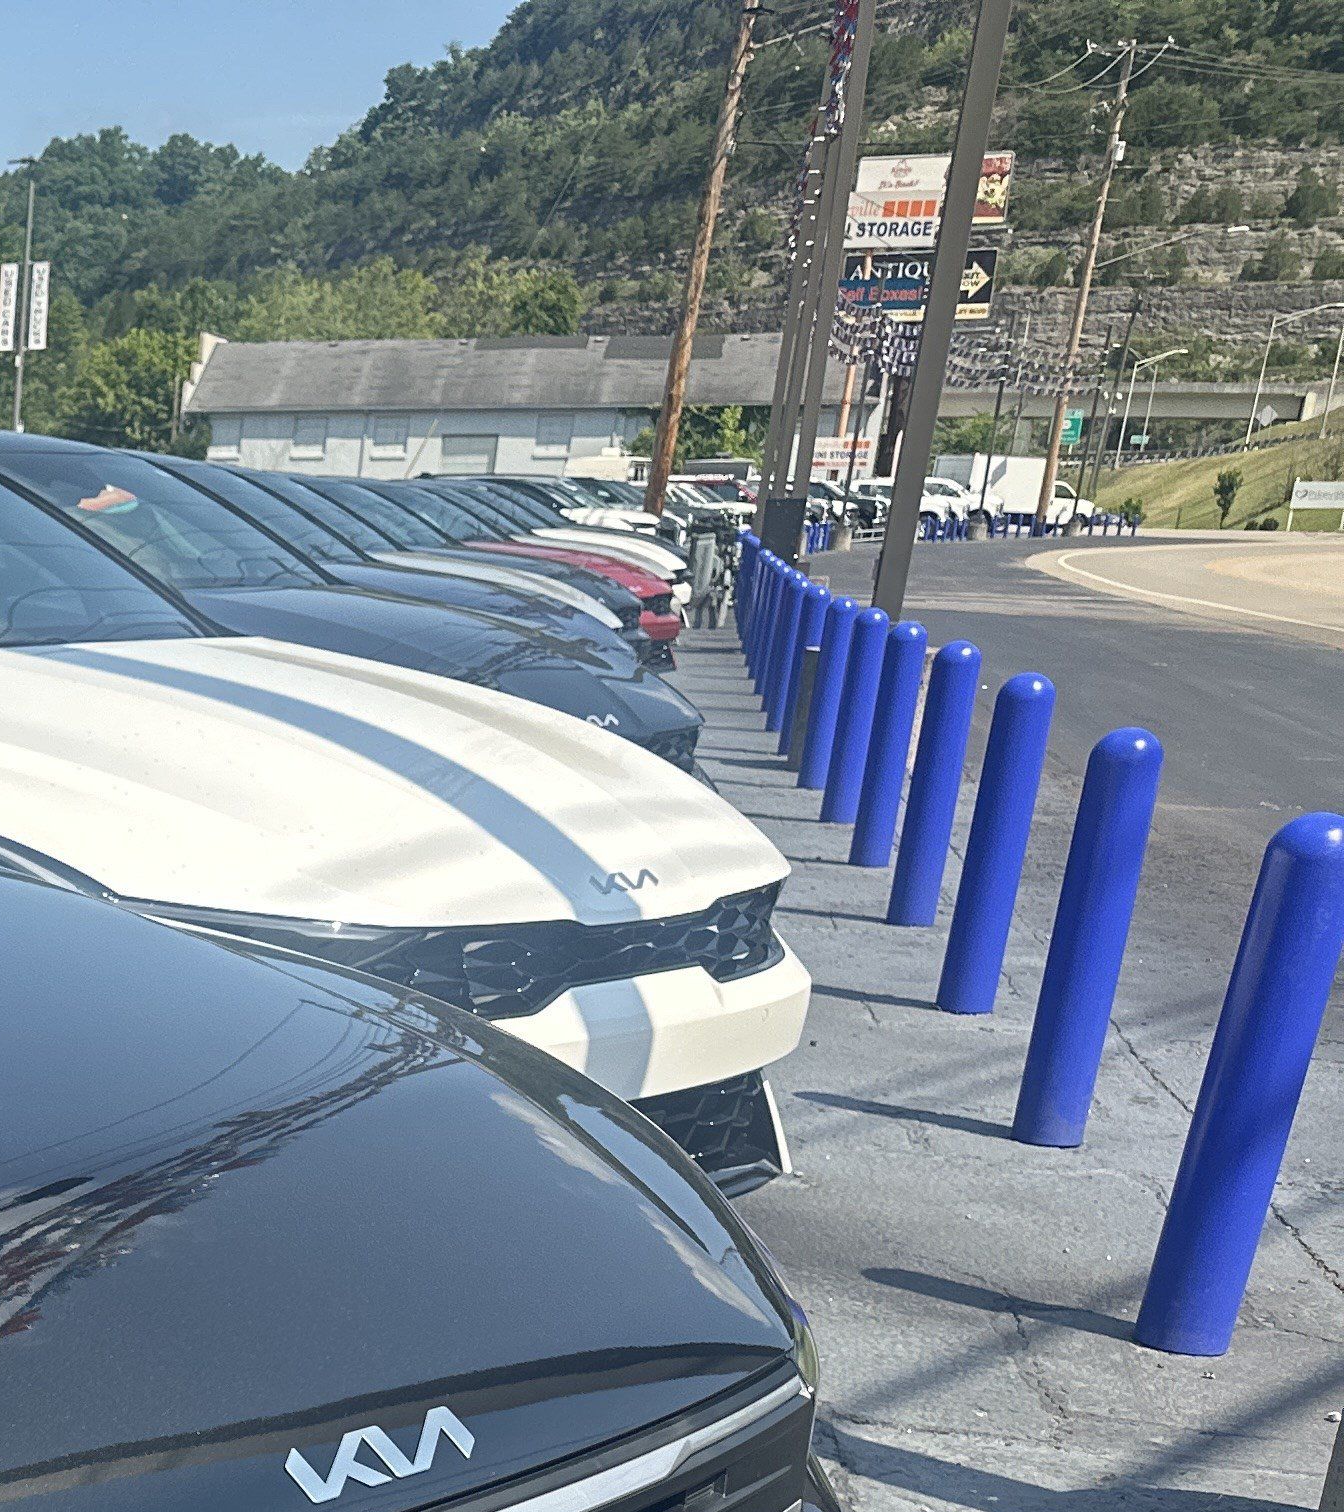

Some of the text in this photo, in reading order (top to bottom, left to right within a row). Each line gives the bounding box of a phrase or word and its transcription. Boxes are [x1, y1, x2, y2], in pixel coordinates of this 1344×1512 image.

[856, 221, 933, 238] STORAGE
[589, 868, 659, 896] KIA
[284, 1405, 476, 1504] KIA
